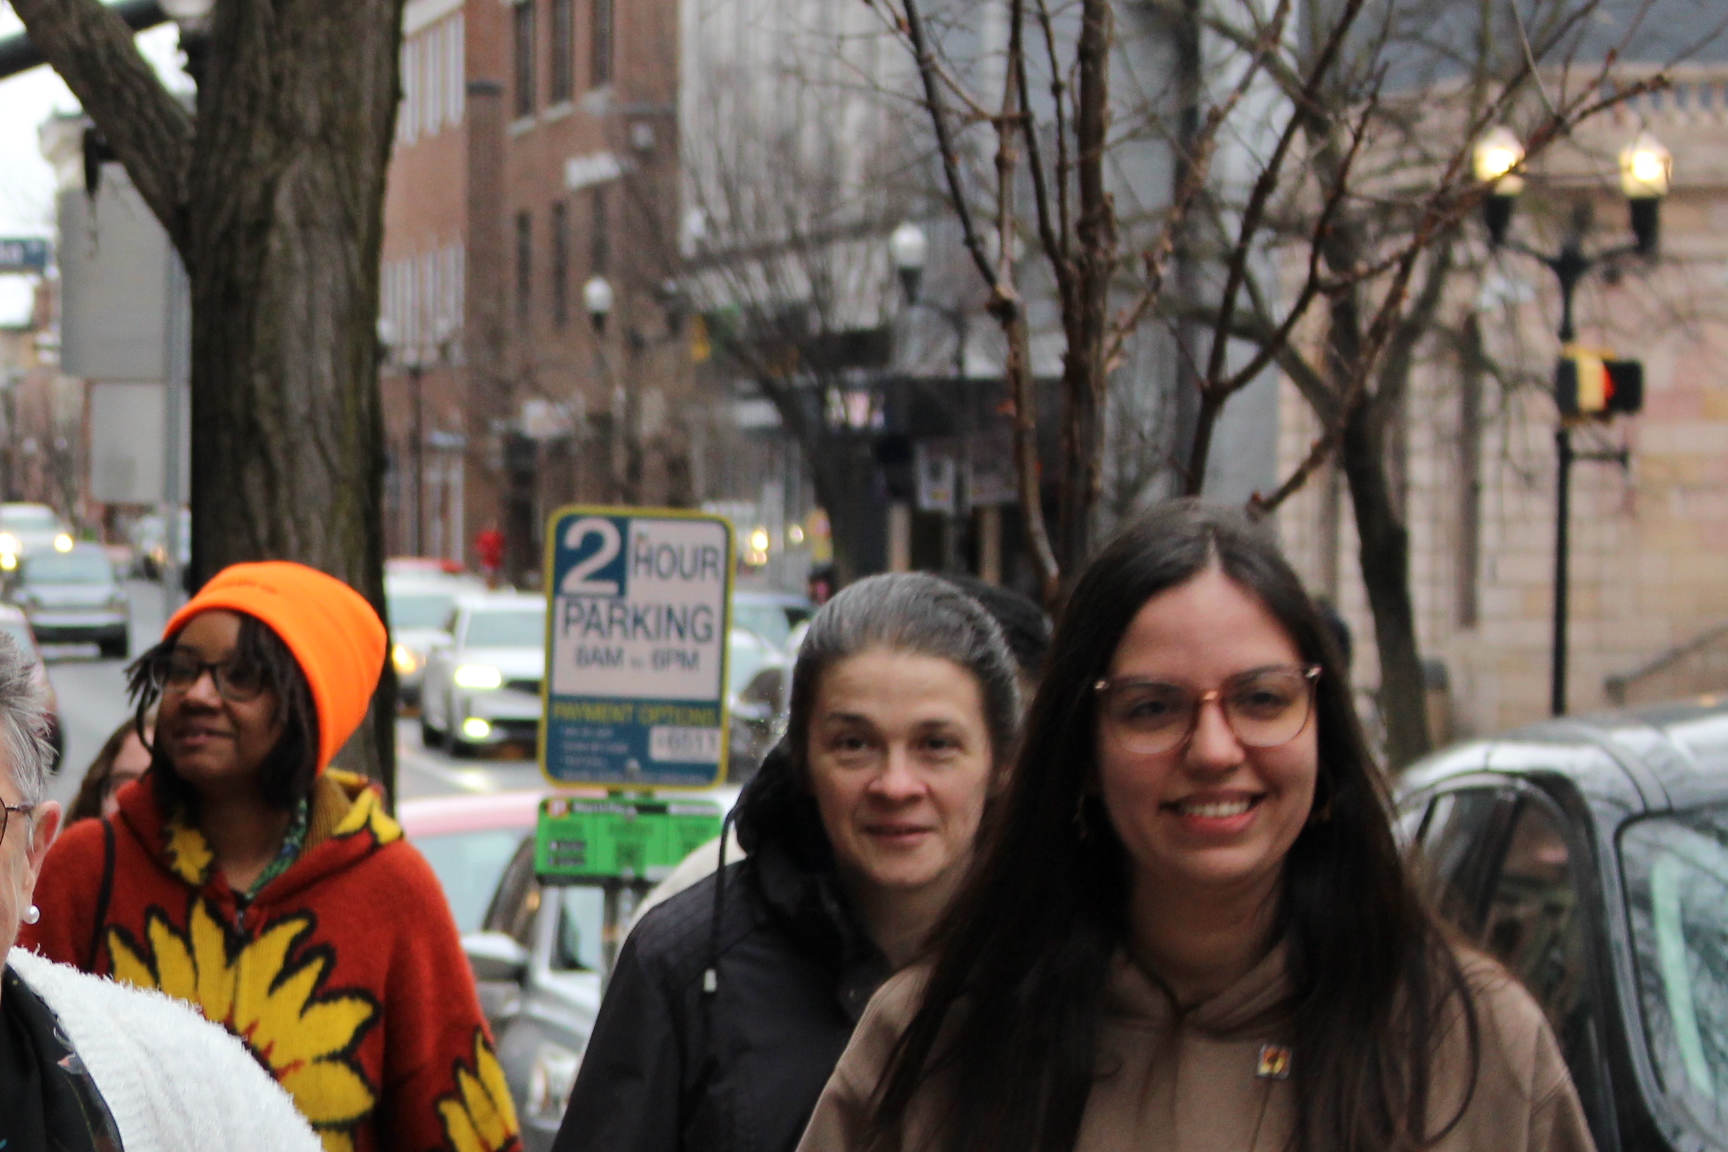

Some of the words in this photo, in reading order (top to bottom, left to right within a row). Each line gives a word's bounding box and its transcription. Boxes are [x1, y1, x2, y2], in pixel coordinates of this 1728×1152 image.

[560, 516, 623, 597] 2
[632, 541, 721, 581] HOUR
[563, 600, 715, 644] PARKING
